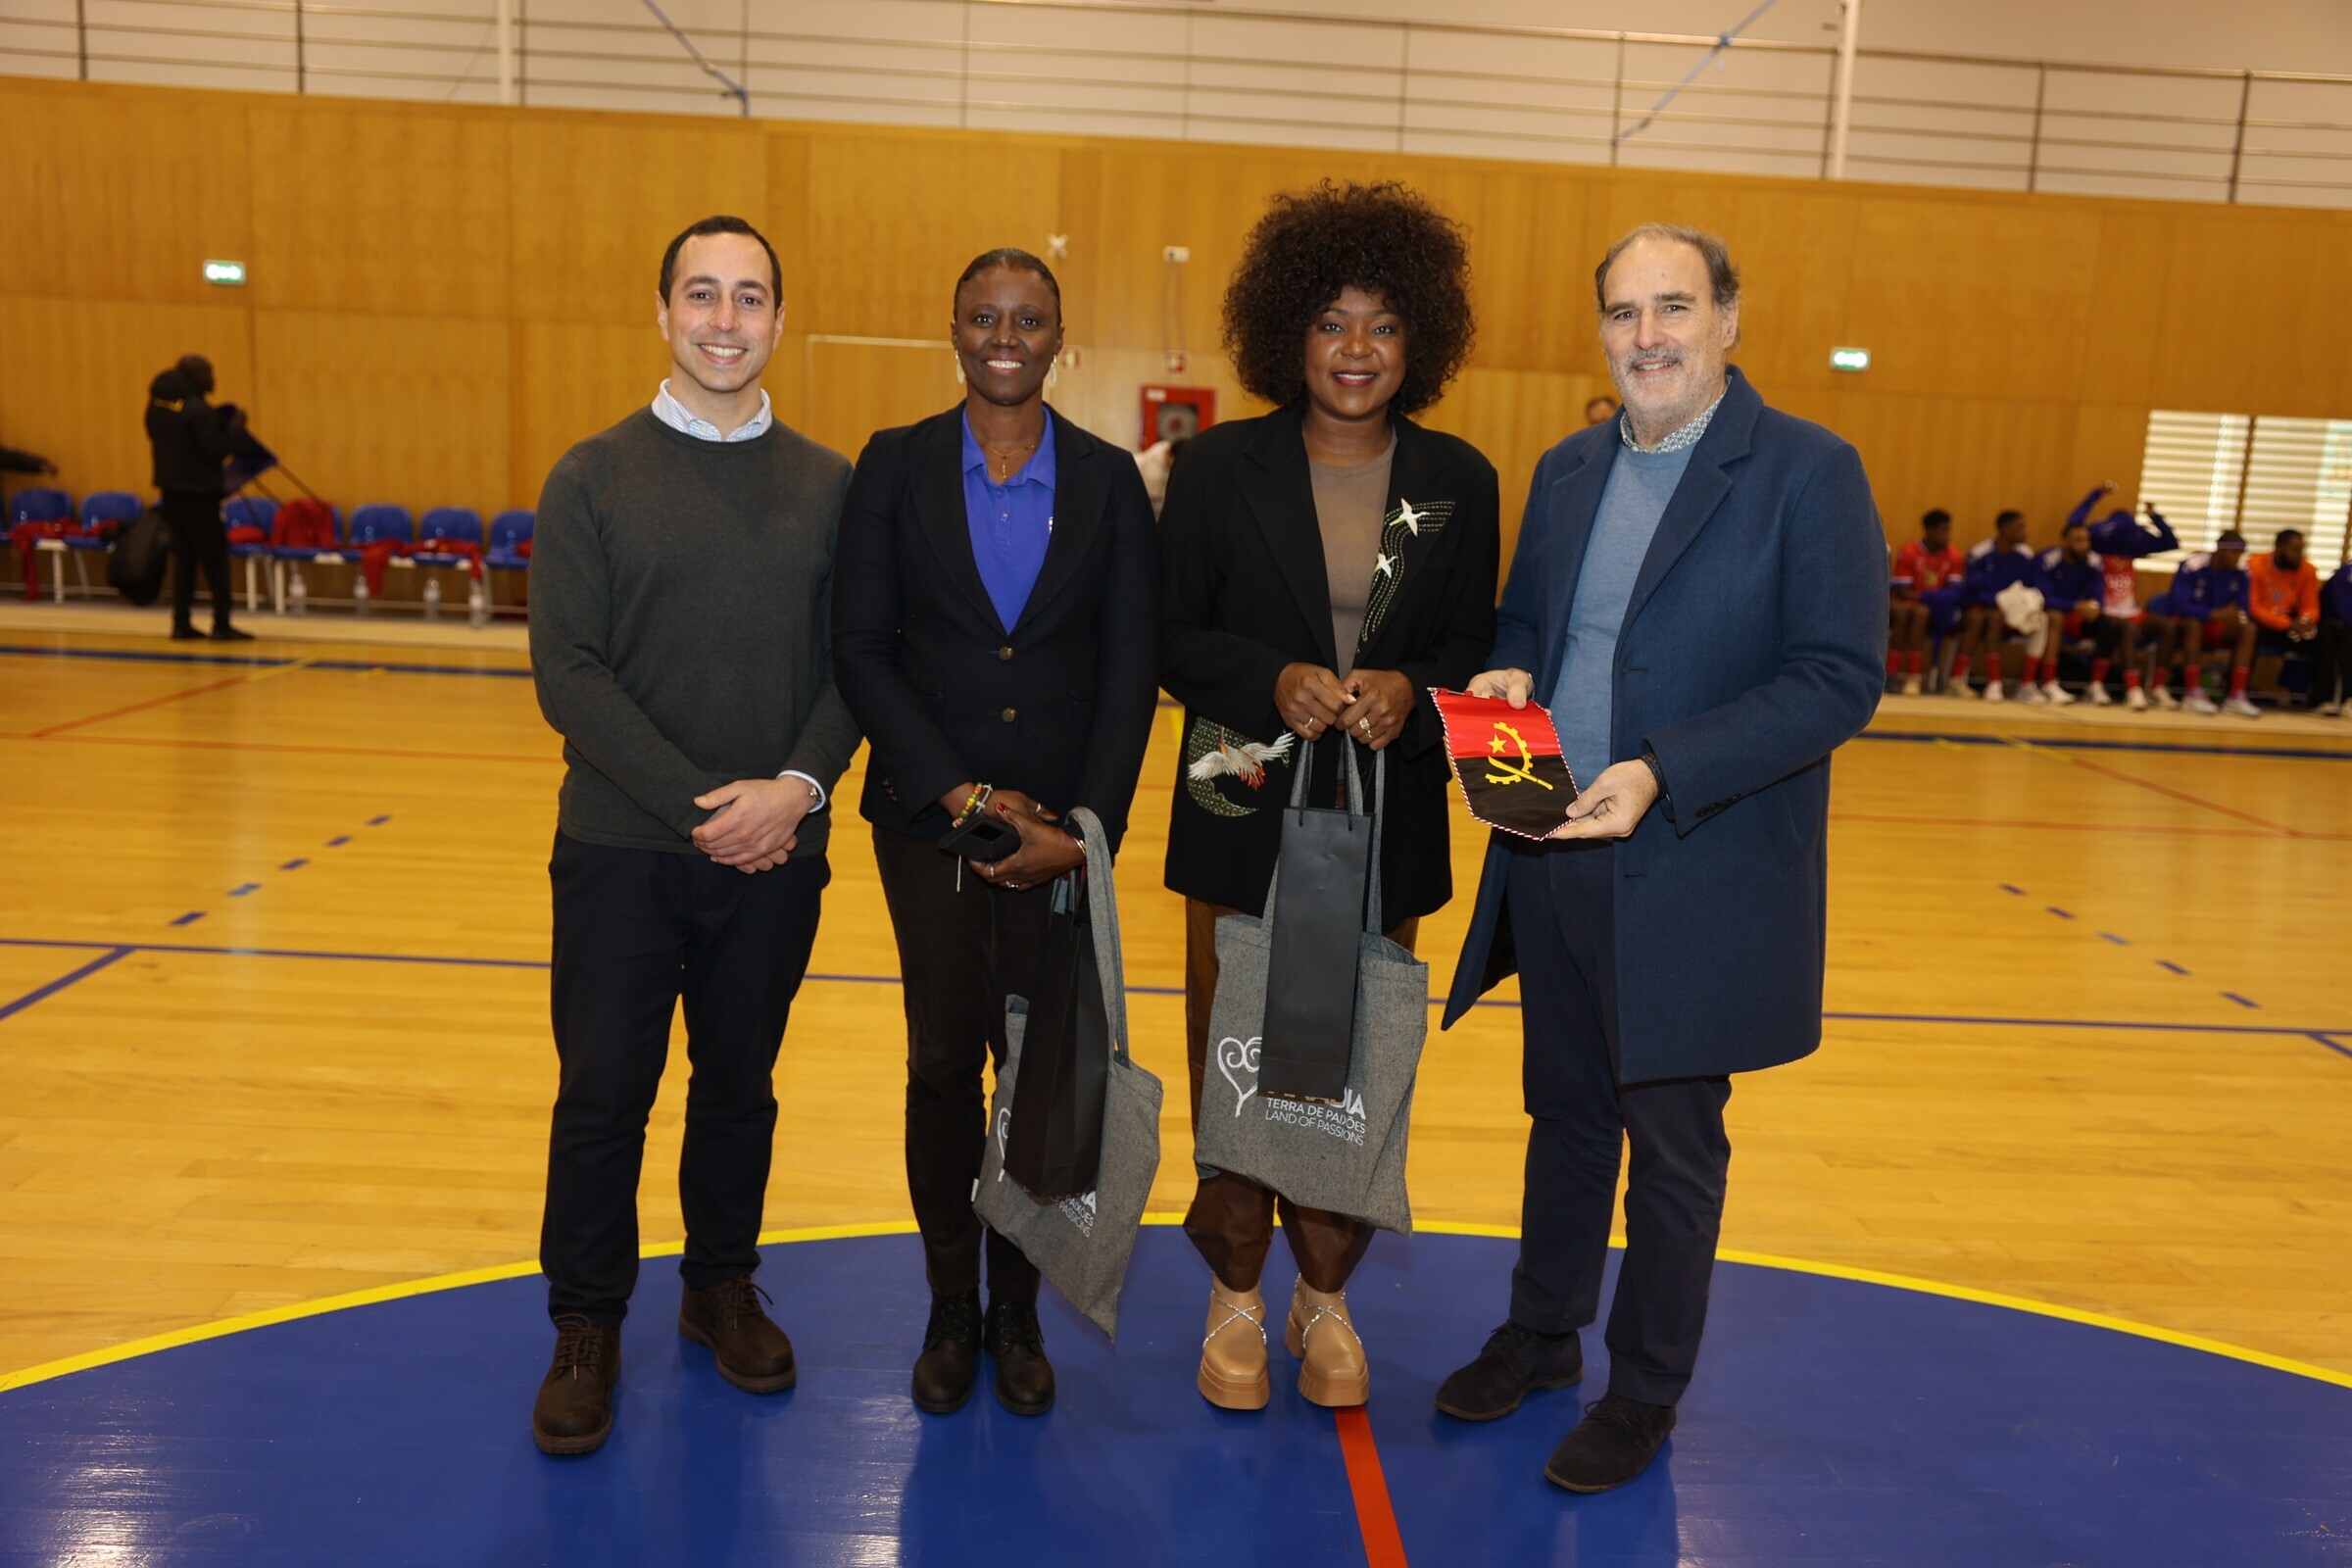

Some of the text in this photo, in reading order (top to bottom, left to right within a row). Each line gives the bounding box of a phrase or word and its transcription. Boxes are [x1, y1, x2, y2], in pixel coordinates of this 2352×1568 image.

[1267, 1098, 1304, 1114] TERRA
[1307, 1104, 1324, 1117] DE
[1265, 1109, 1364, 1146] LAND OF PASSIONS
